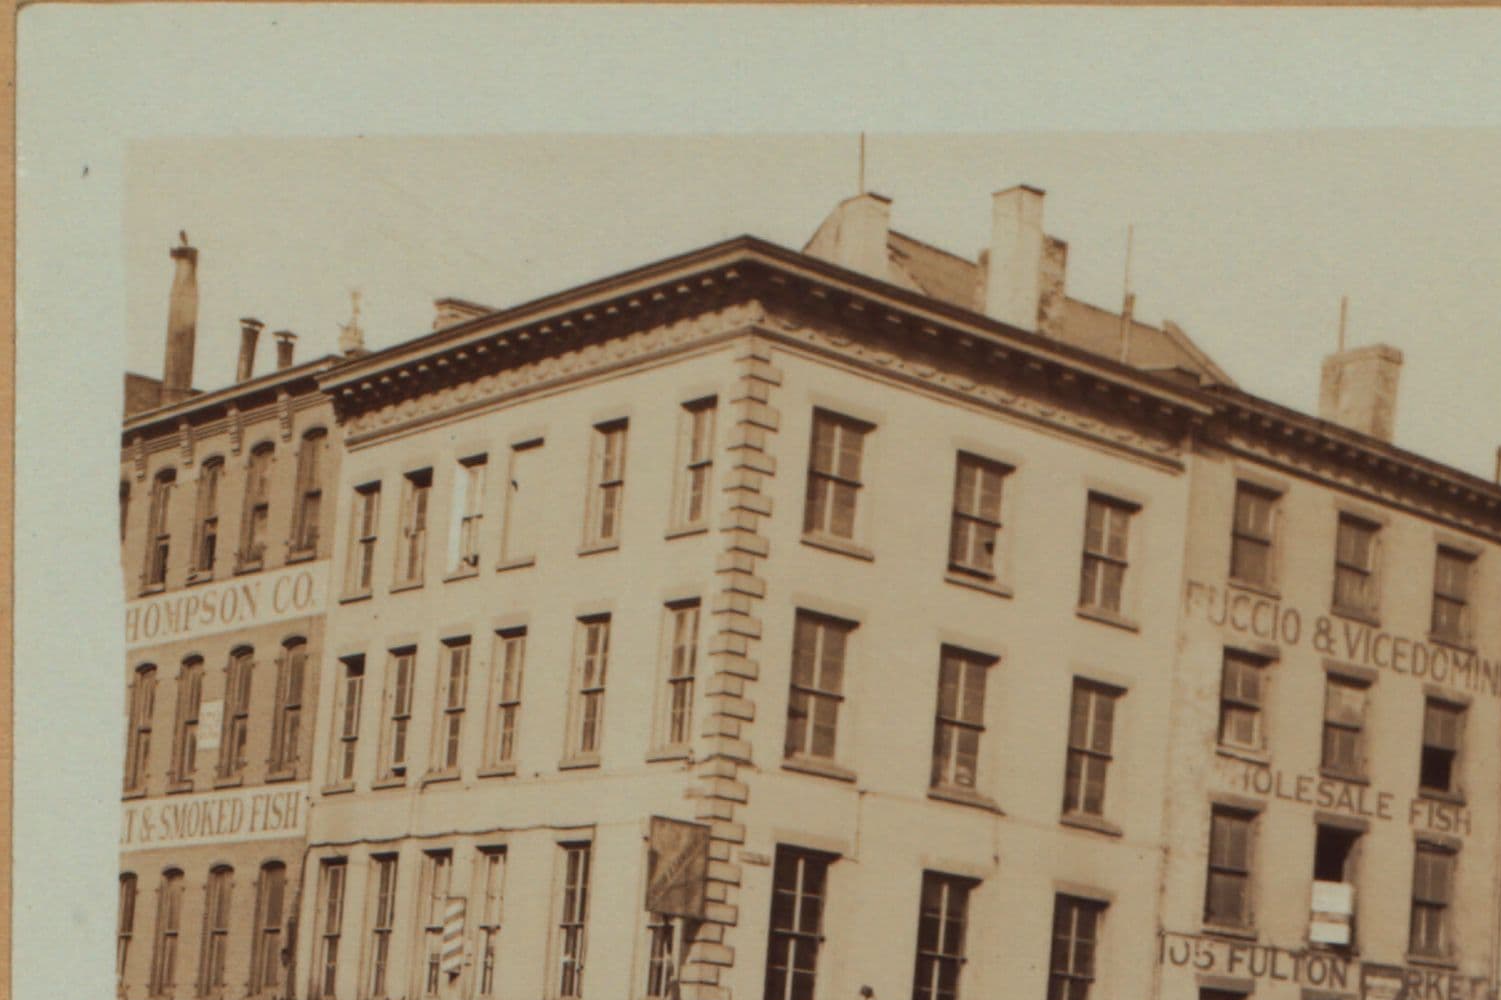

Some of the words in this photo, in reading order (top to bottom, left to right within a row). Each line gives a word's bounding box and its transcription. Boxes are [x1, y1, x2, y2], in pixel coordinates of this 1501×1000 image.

[273, 569, 316, 614] CO.
[1312, 615, 1337, 656] &
[141, 804, 156, 841] &
[159, 796, 244, 841] SMOKED
[248, 790, 301, 833] FISH
[1233, 767, 1393, 821] OLESALE
[1408, 799, 1472, 836] FISH
[1227, 945, 1349, 990] FULTON
